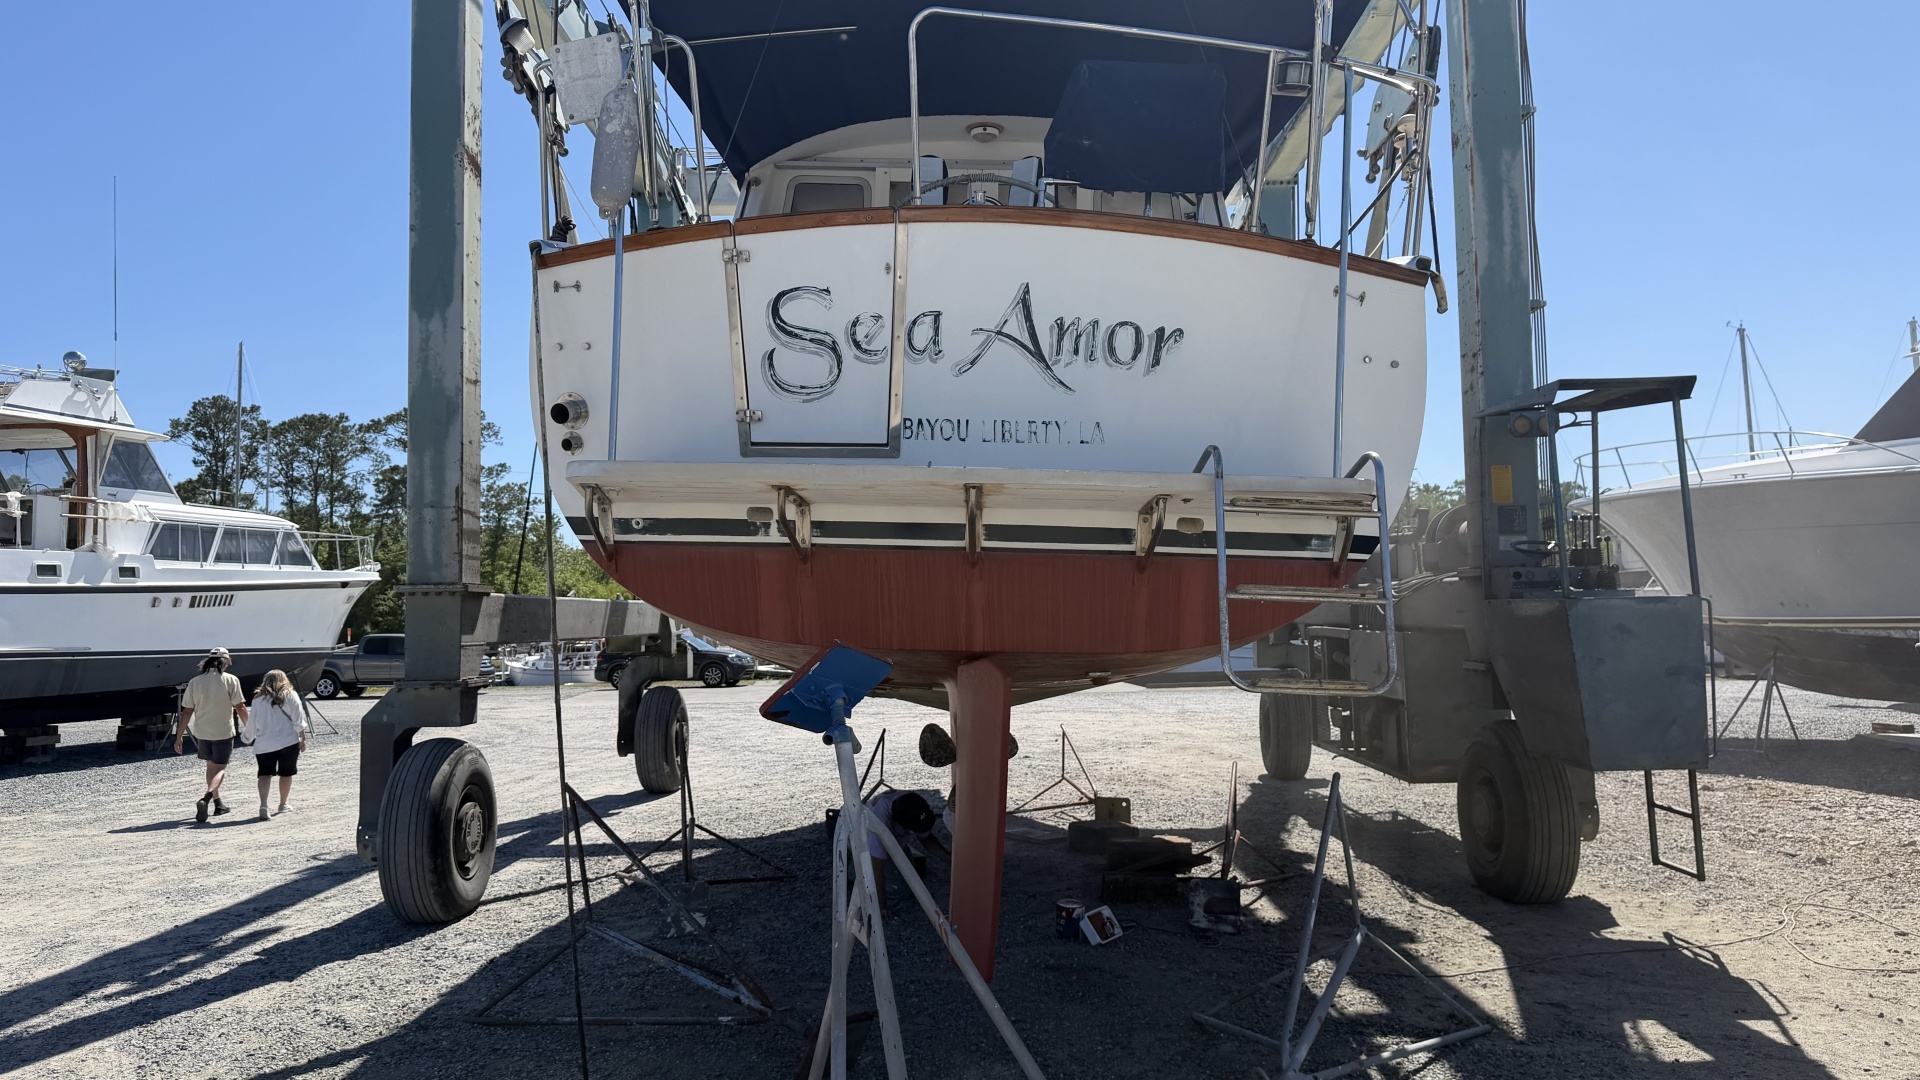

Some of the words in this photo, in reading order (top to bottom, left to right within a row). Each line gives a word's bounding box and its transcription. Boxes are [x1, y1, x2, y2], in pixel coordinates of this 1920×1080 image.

[761, 285, 945, 403] Sea
[951, 281, 1185, 396] Amor
[902, 417, 970, 442] BAYOU
[1079, 420, 1106, 445] LA
